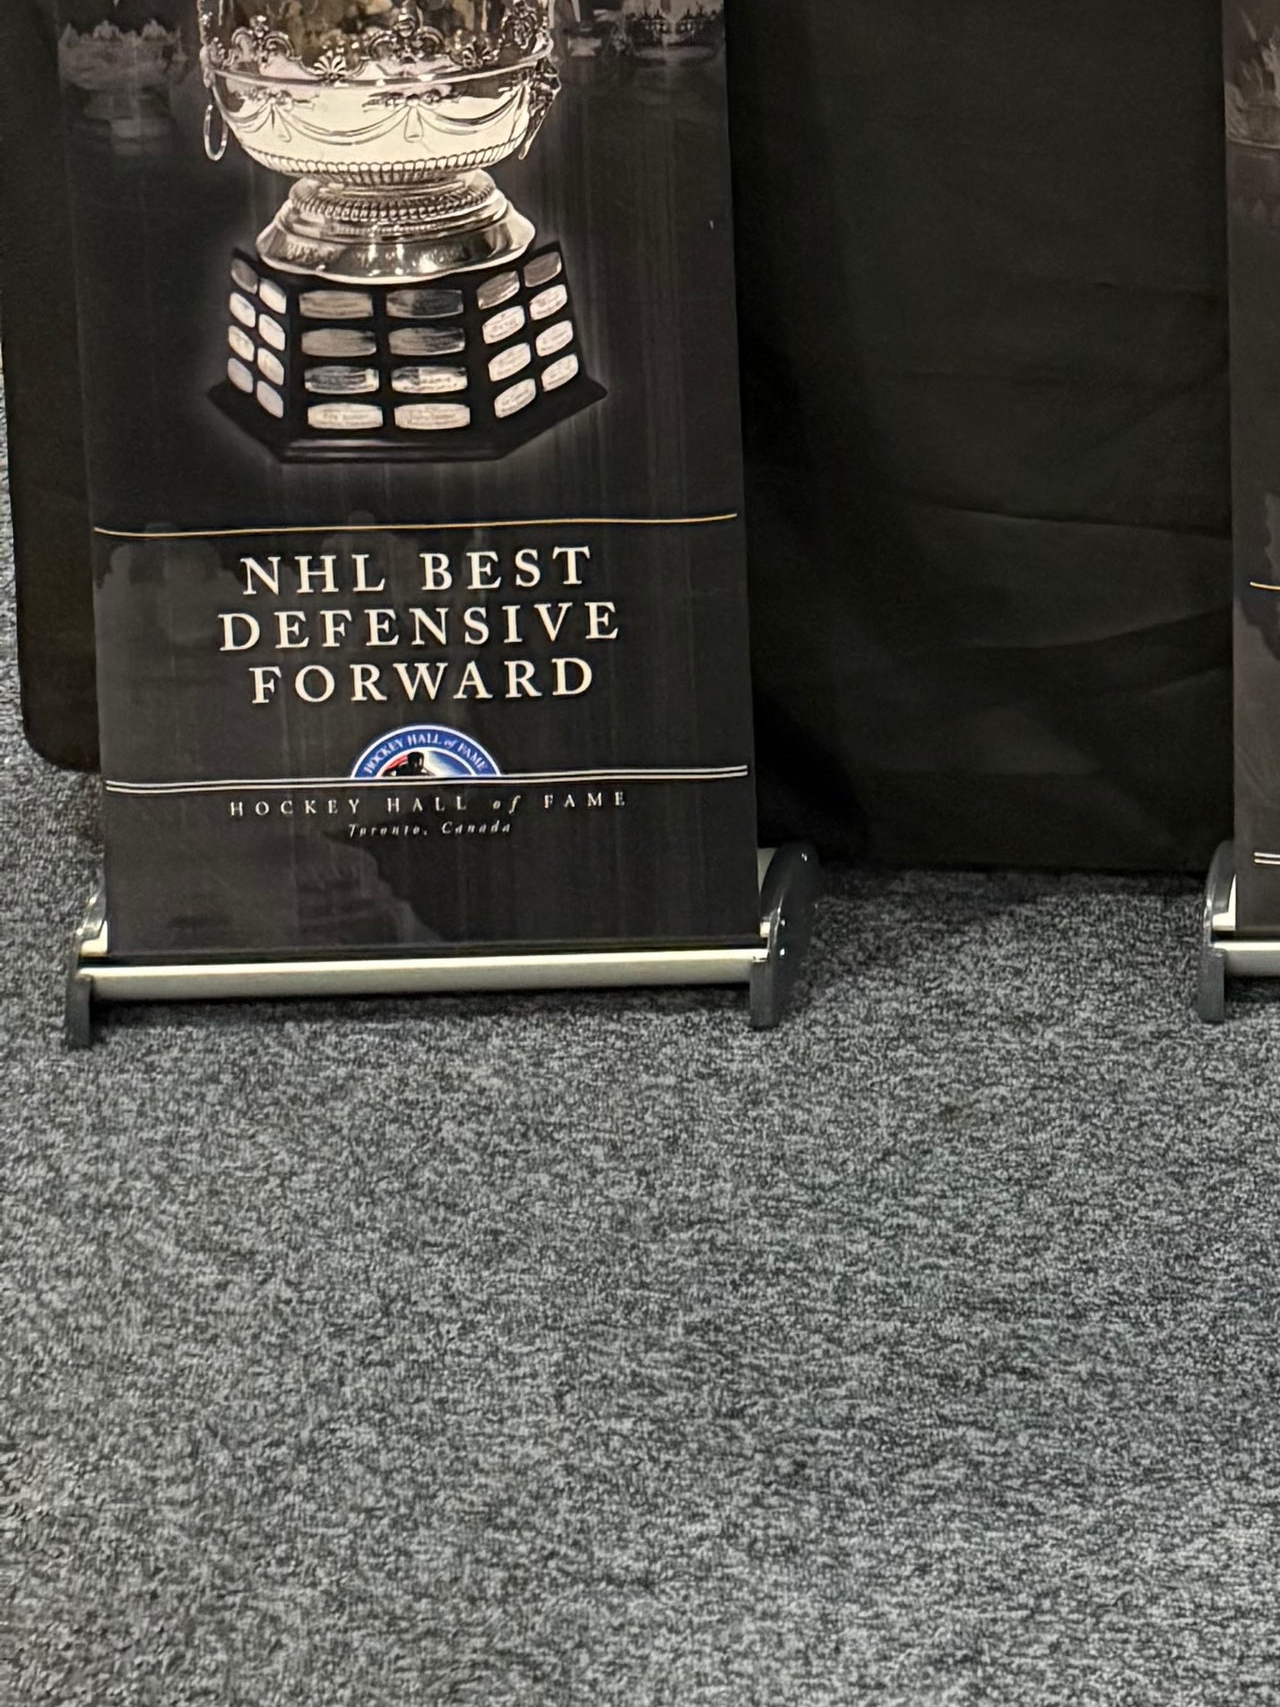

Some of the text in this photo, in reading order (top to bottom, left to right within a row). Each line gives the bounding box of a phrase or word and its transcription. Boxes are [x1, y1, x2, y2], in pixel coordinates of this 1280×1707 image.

[239, 546, 591, 596] NHL BEST
[217, 601, 619, 652] DEFENSIVE
[248, 657, 593, 704] FORWARD
[229, 791, 625, 816] HOCKEY HALL of FAME
